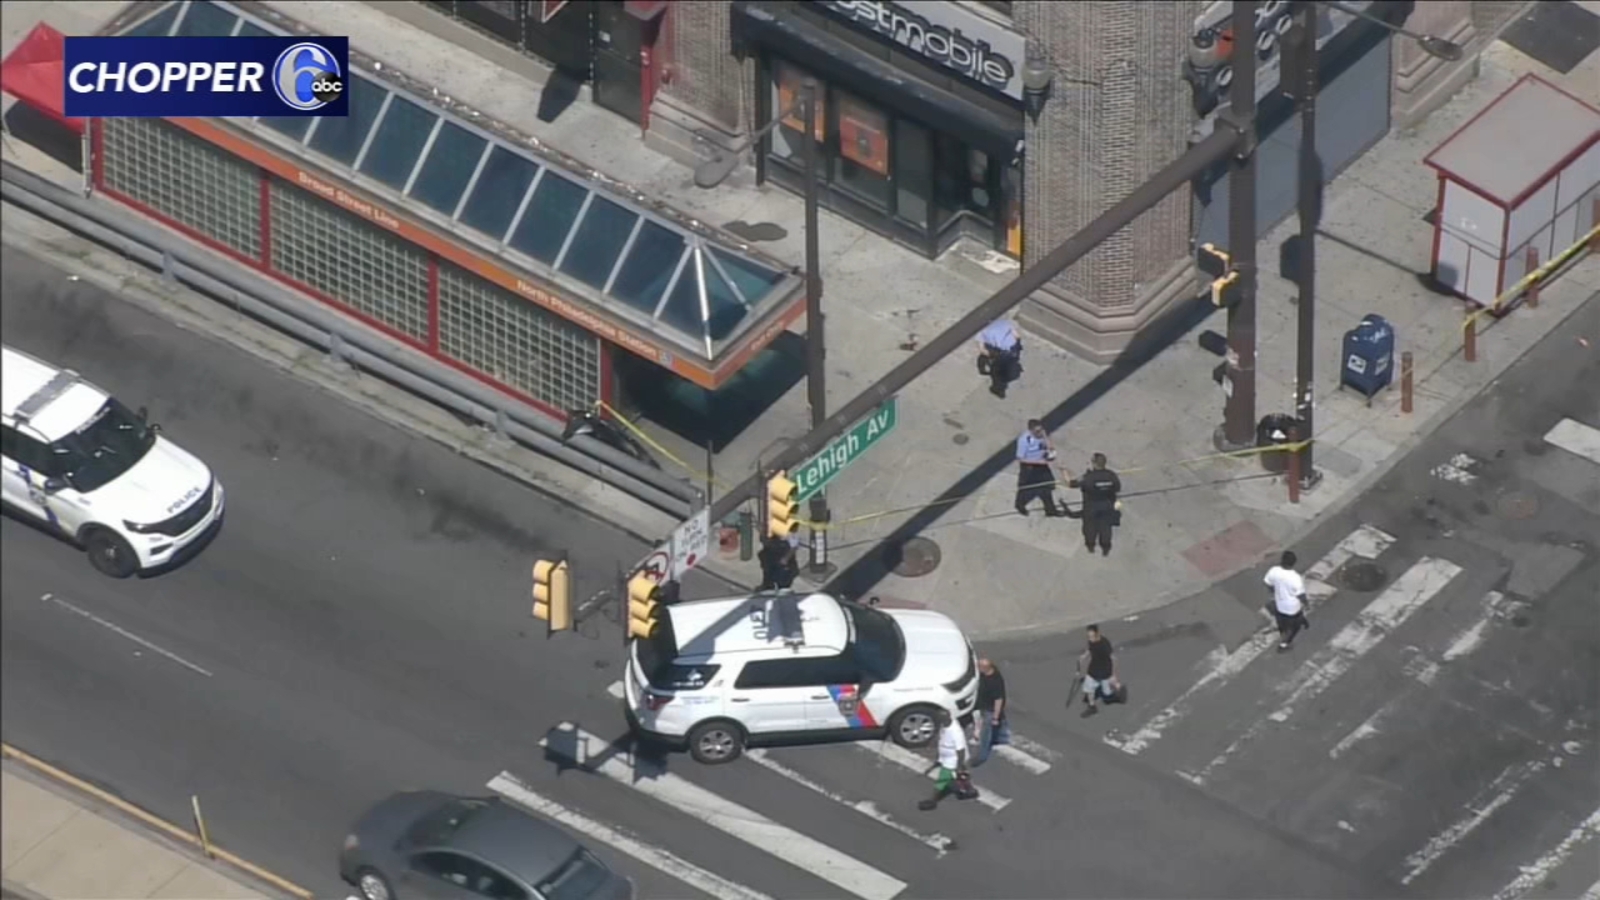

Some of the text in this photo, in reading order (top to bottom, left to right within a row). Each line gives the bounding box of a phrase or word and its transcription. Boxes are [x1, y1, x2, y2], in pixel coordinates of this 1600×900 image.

[299, 171, 399, 229] Broad Street Line
[516, 279, 548, 301] North
[617, 329, 658, 356] Station
[796, 409, 889, 494] Lehigh Av
[167, 487, 201, 514] POLICE
